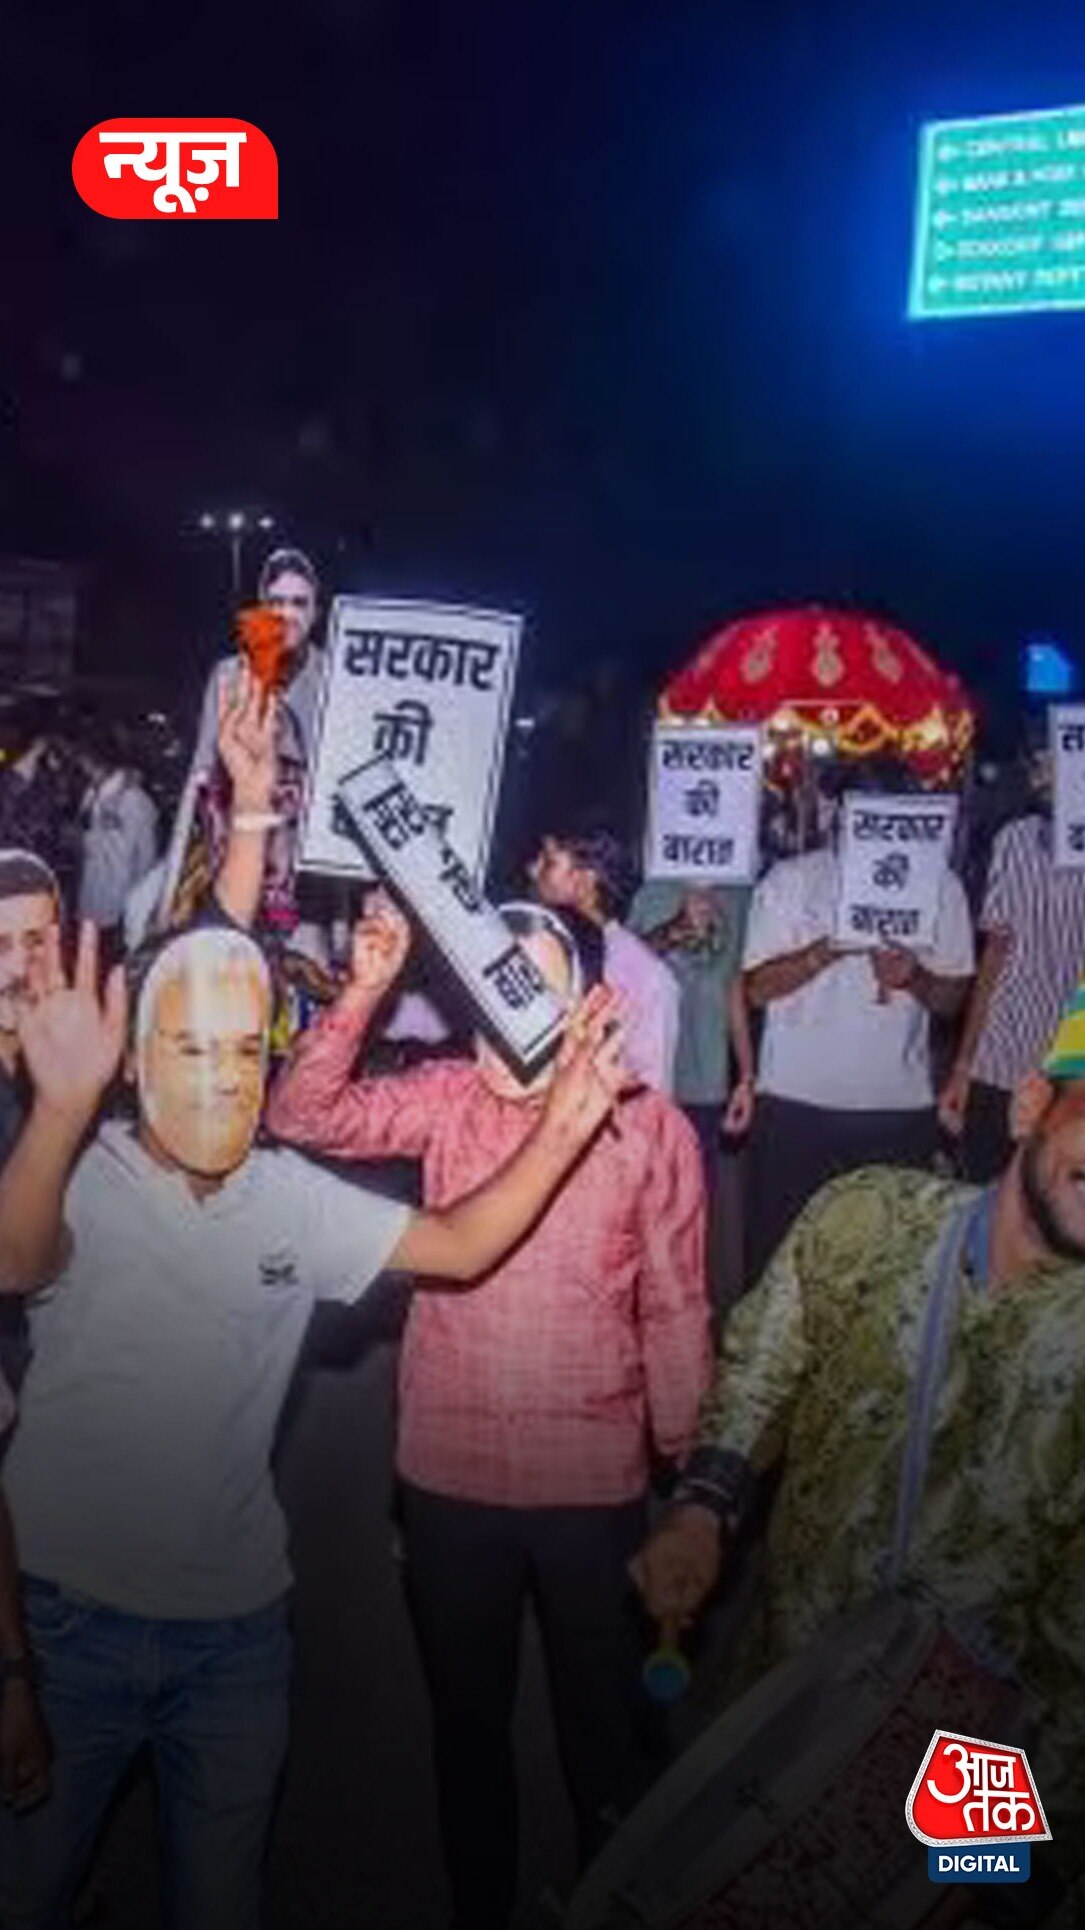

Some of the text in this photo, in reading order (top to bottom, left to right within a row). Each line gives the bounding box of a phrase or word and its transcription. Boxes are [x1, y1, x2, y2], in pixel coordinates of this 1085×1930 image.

[344, 629, 499, 690] सरकार
[373, 699, 433, 765] की
[661, 740, 754, 771] सरकार
[684, 779, 720, 817] की
[852, 810, 945, 842] सरकार
[872, 851, 909, 890] की
